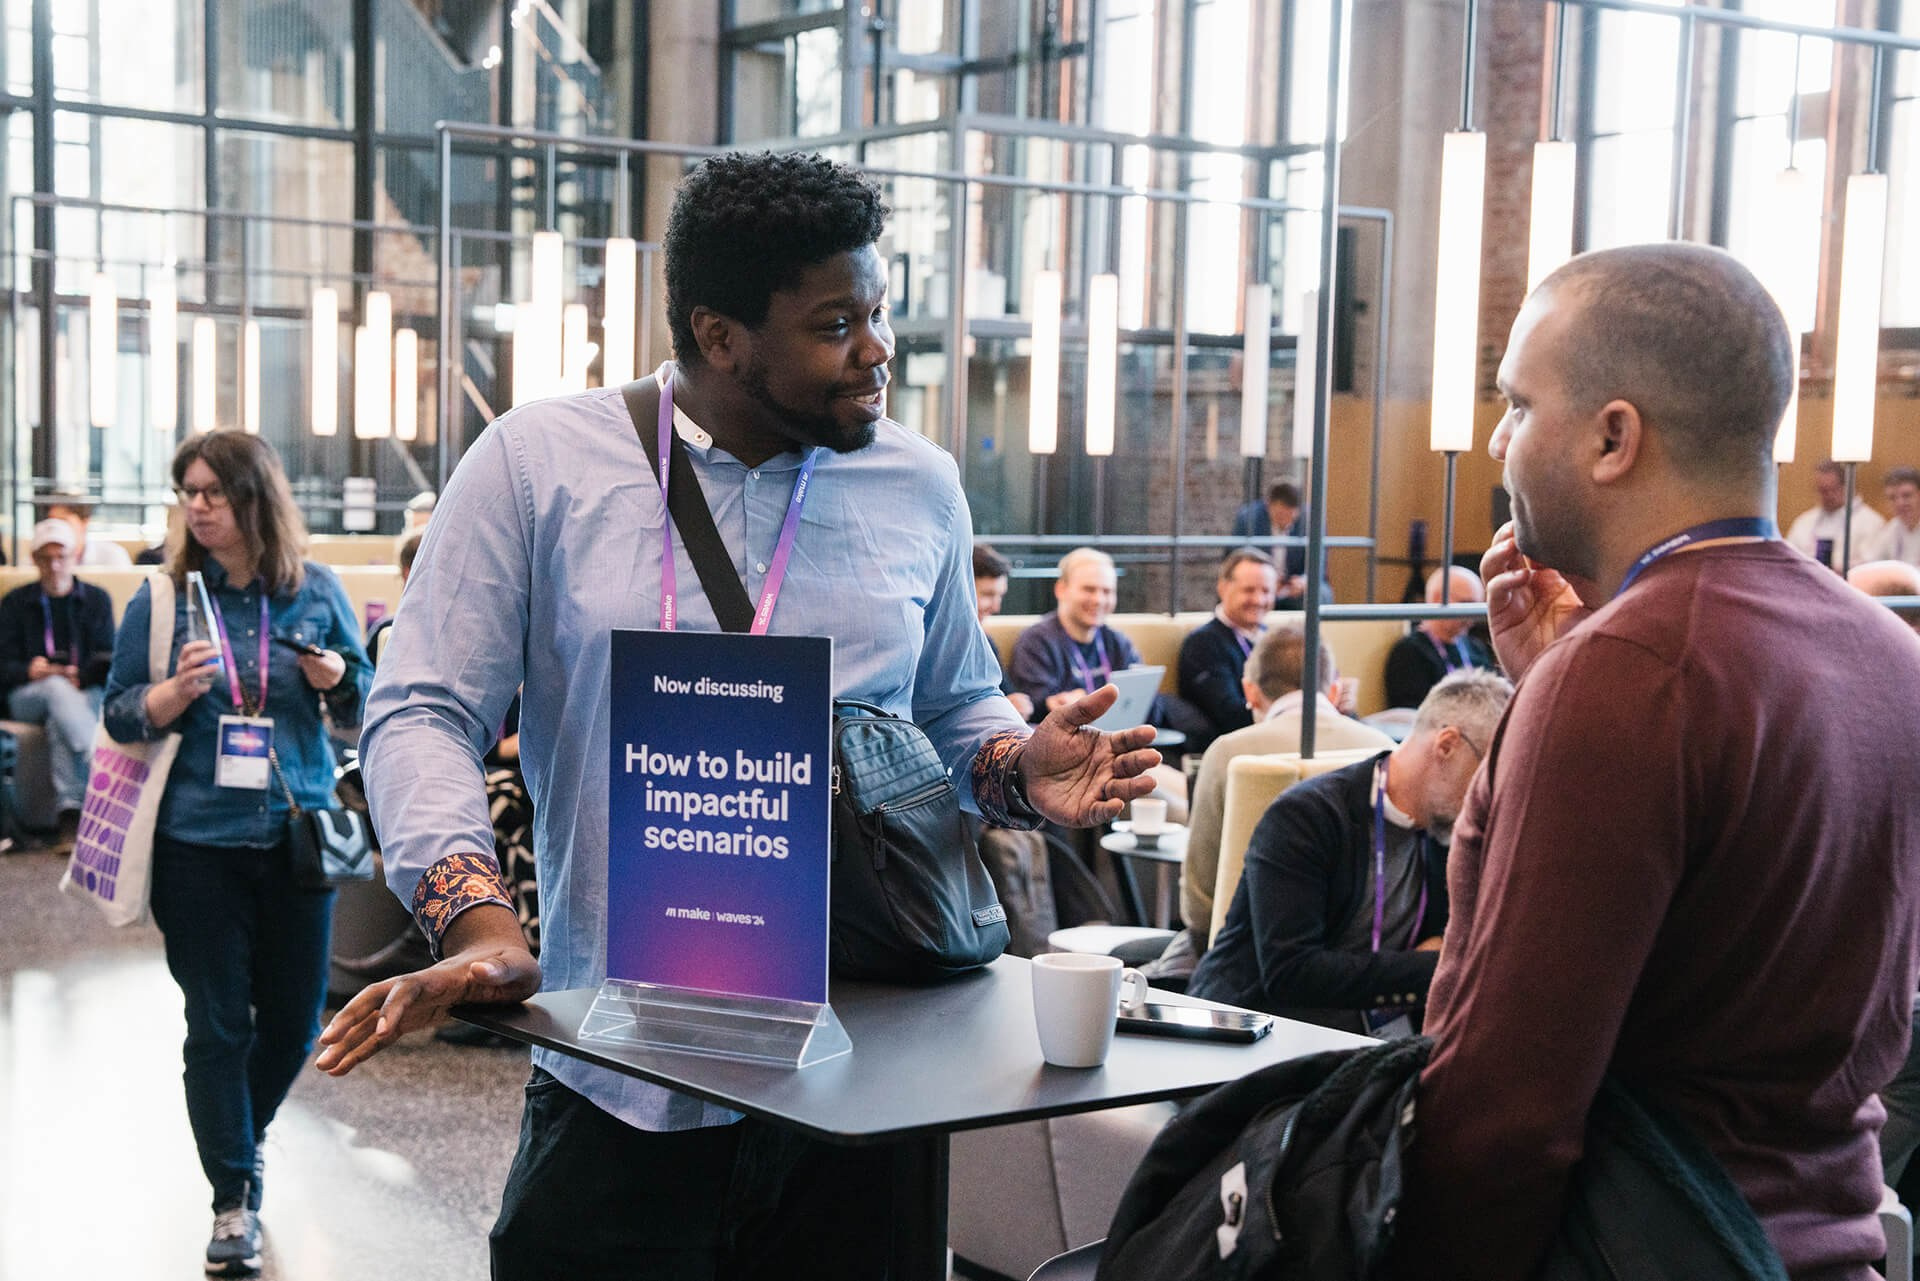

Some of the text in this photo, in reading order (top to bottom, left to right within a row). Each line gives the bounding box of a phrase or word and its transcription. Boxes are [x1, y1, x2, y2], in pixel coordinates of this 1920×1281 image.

[654, 676, 784, 703] Now discussing
[625, 743, 811, 785] How to build
[646, 781, 788, 821] impactful
[644, 826, 789, 859] scenarios
[678, 907, 711, 920] make
